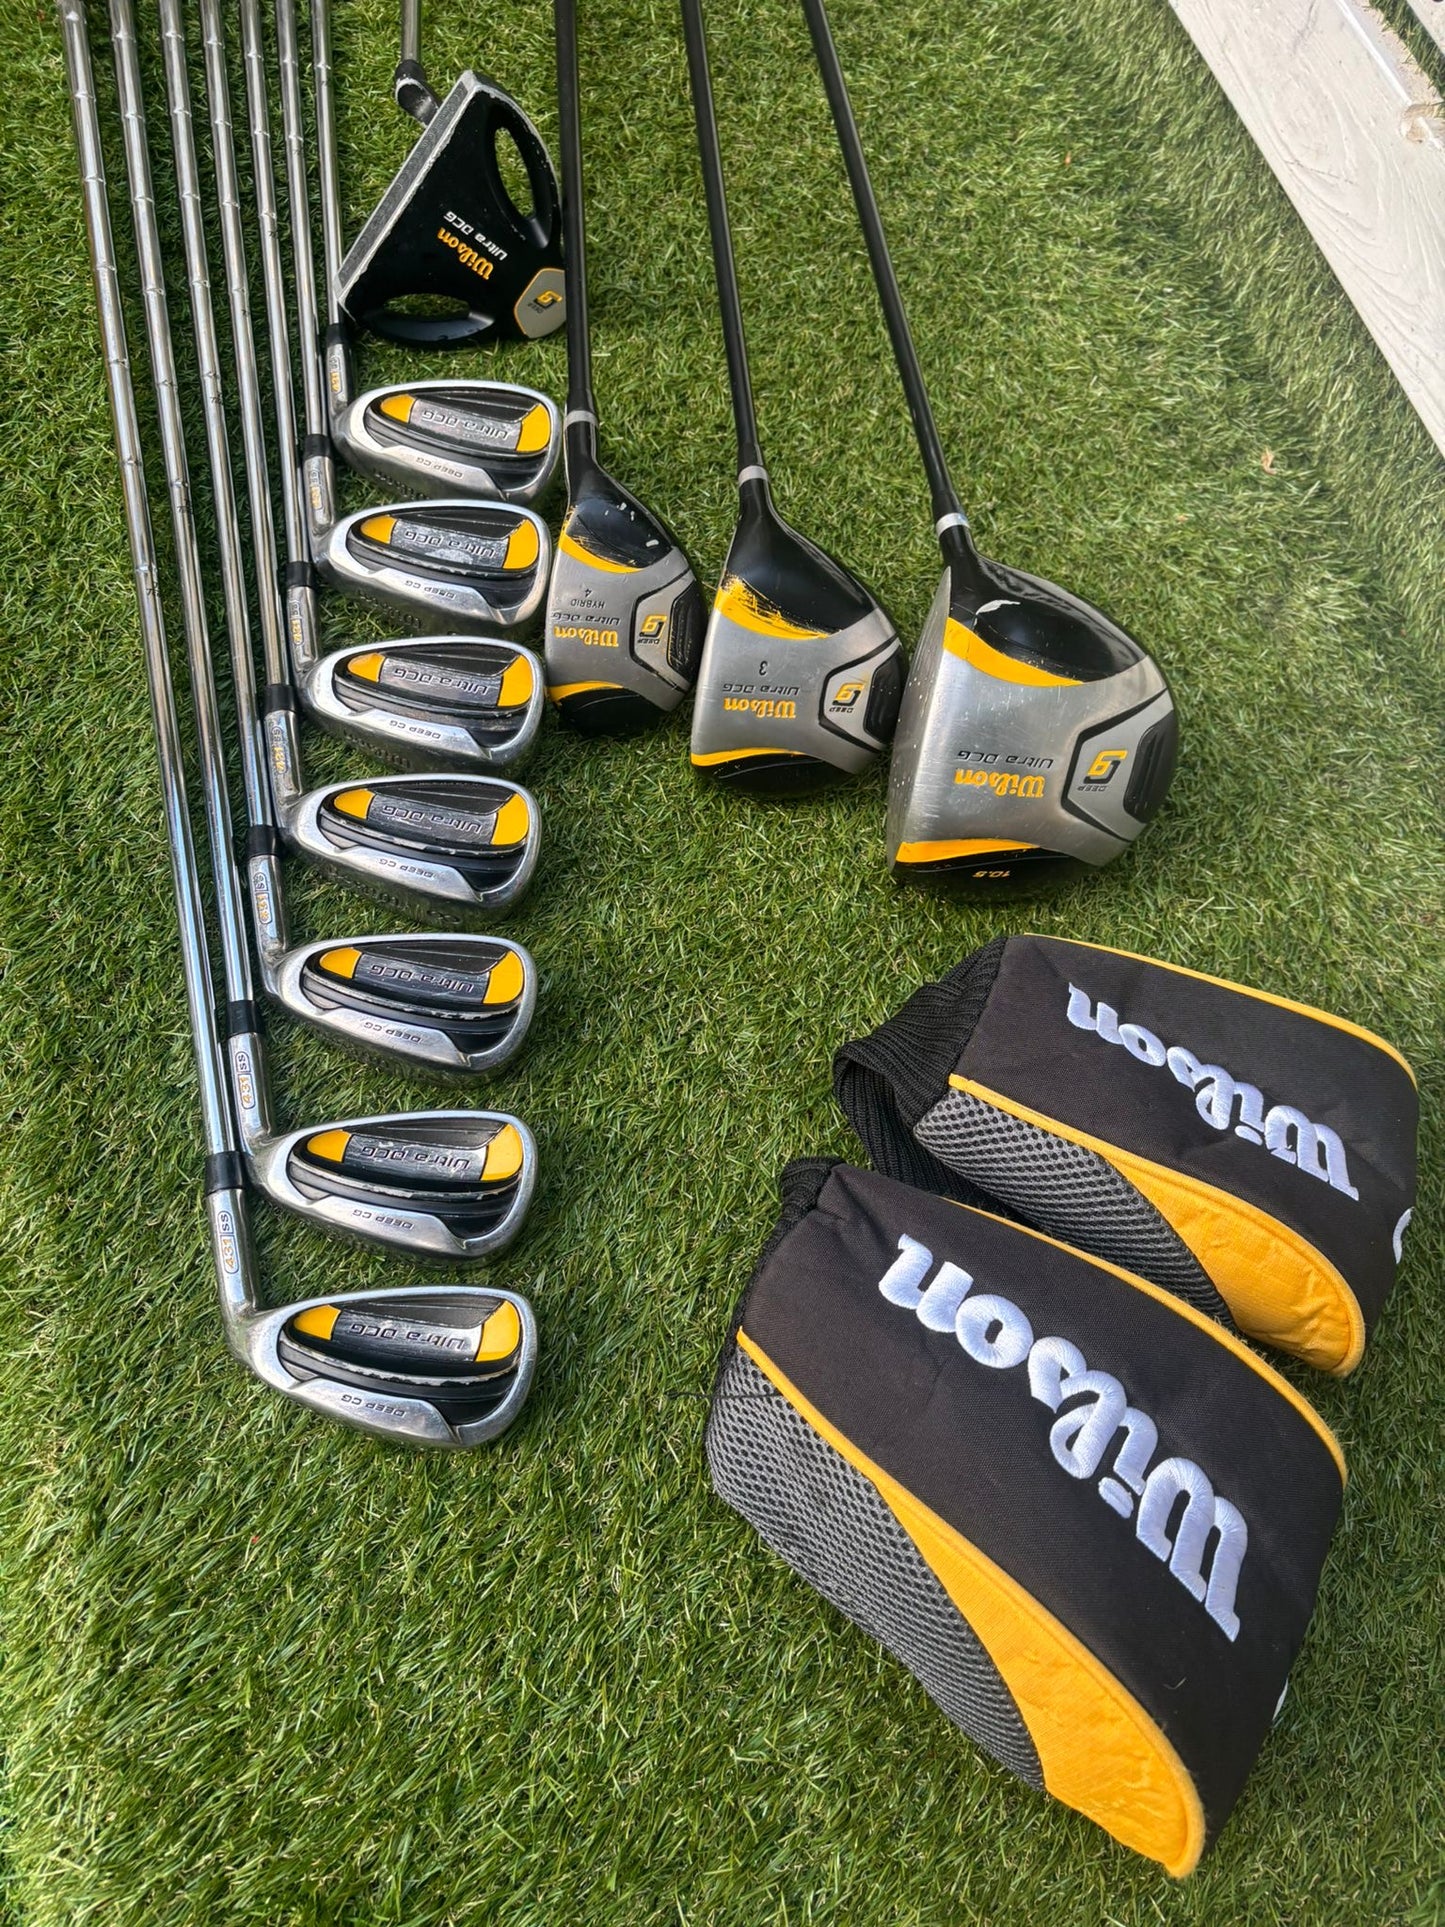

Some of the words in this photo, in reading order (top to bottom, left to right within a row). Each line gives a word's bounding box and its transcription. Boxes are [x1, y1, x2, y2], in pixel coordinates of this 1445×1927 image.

[443, 210, 474, 236] DCG
[436, 226, 495, 281] Wilson
[477, 232, 509, 262] Ultra
[422, 408, 458, 428] DCG
[464, 421, 511, 441] Ultra
[416, 456, 432, 467] CG
[433, 464, 465, 479] DEEP
[404, 530, 444, 547] DCG
[449, 539, 497, 558] Ultra
[404, 579, 422, 589] CG
[423, 586, 457, 600] DEEP
[584, 588, 593, 598] 4
[570, 598, 606, 609] HYBRID
[551, 611, 580, 622] DCG
[585, 615, 621, 626] Ultra
[553, 626, 619, 648] Wilson
[394, 667, 432, 684] DCG
[758, 660, 769, 677] 3
[439, 676, 490, 696] Ultra
[722, 682, 755, 694] DCG
[760, 685, 800, 696] Ultra
[723, 697, 797, 719] Wilson
[389, 720, 406, 730] CG
[409, 725, 441, 740] DEEP
[957, 750, 999, 764] DCG
[1005, 755, 1055, 769] Ultra
[954, 768, 1046, 798] Wilson
[1076, 785, 1108, 793] DEEP
[381, 804, 424, 822] DCG
[430, 814, 483, 834] Ultra
[378, 858, 397, 868] CG
[399, 864, 435, 879] DEEP
[972, 870, 1011, 878] 10.5
[369, 964, 414, 980] DCG
[420, 973, 475, 993] Ultra
[363, 1021, 384, 1031] CG
[386, 1028, 422, 1043] DEEP
[239, 1076, 252, 1104] 431
[1066, 982, 1359, 1201] Wilson
[361, 1146, 407, 1160] DCG
[414, 1152, 471, 1170] Ultra
[353, 1208, 371, 1219] CG
[375, 1215, 414, 1231] DEEP
[222, 1238, 236, 1270] 431
[350, 1323, 397, 1339] DCG
[406, 1331, 466, 1350] Ultra
[340, 1394, 363, 1405] CG
[365, 1402, 406, 1417] DEEP
[878, 1233, 1249, 1642] Wilson
